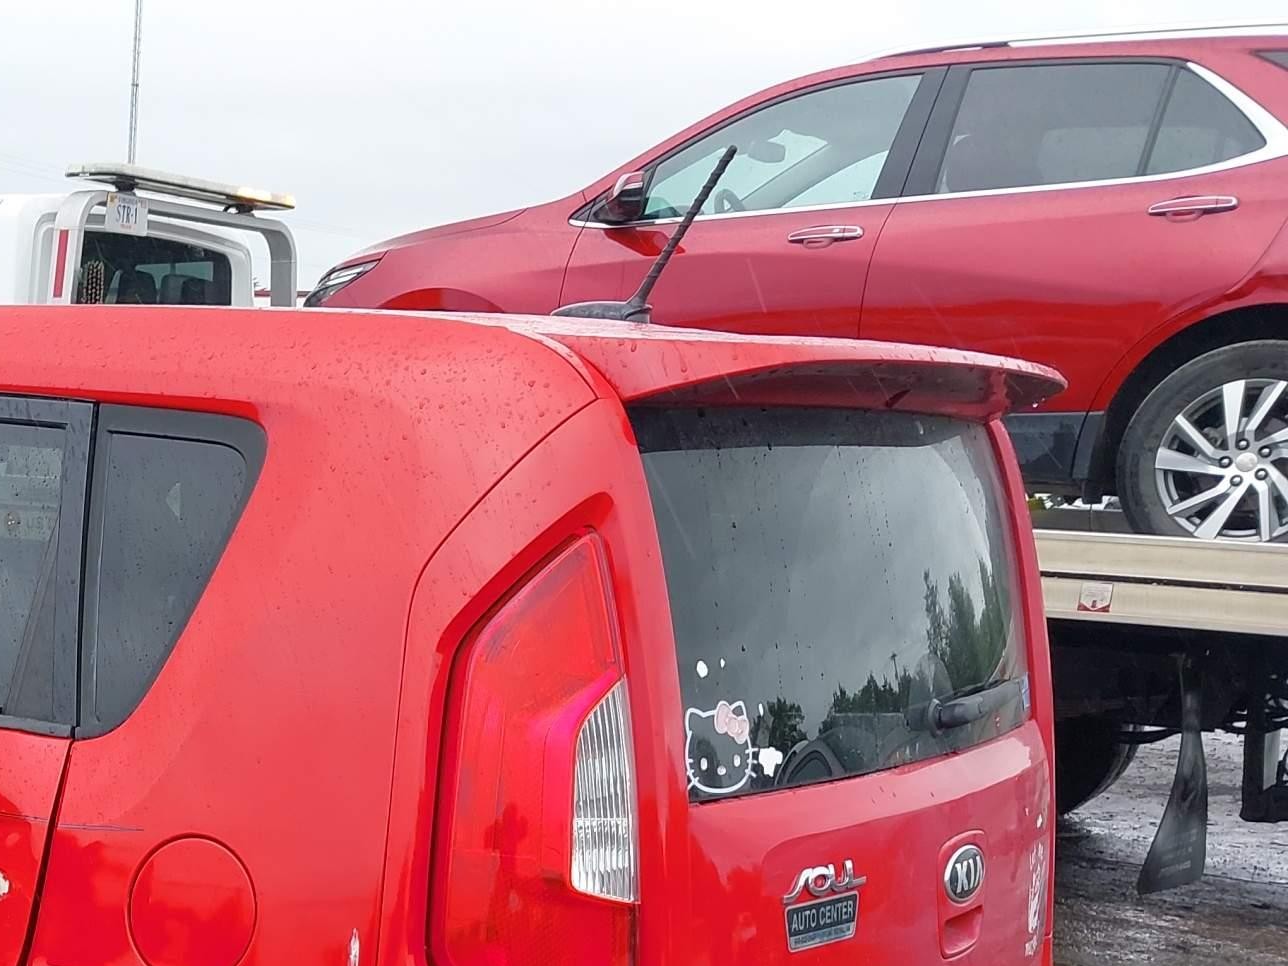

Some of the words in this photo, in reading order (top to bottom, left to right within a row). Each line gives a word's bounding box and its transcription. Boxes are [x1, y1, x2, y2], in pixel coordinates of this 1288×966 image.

[783, 859, 867, 903] SOUL
[954, 855, 981, 893] KIA
[791, 908, 817, 933] AUTO
[819, 900, 854, 926] CENTER
